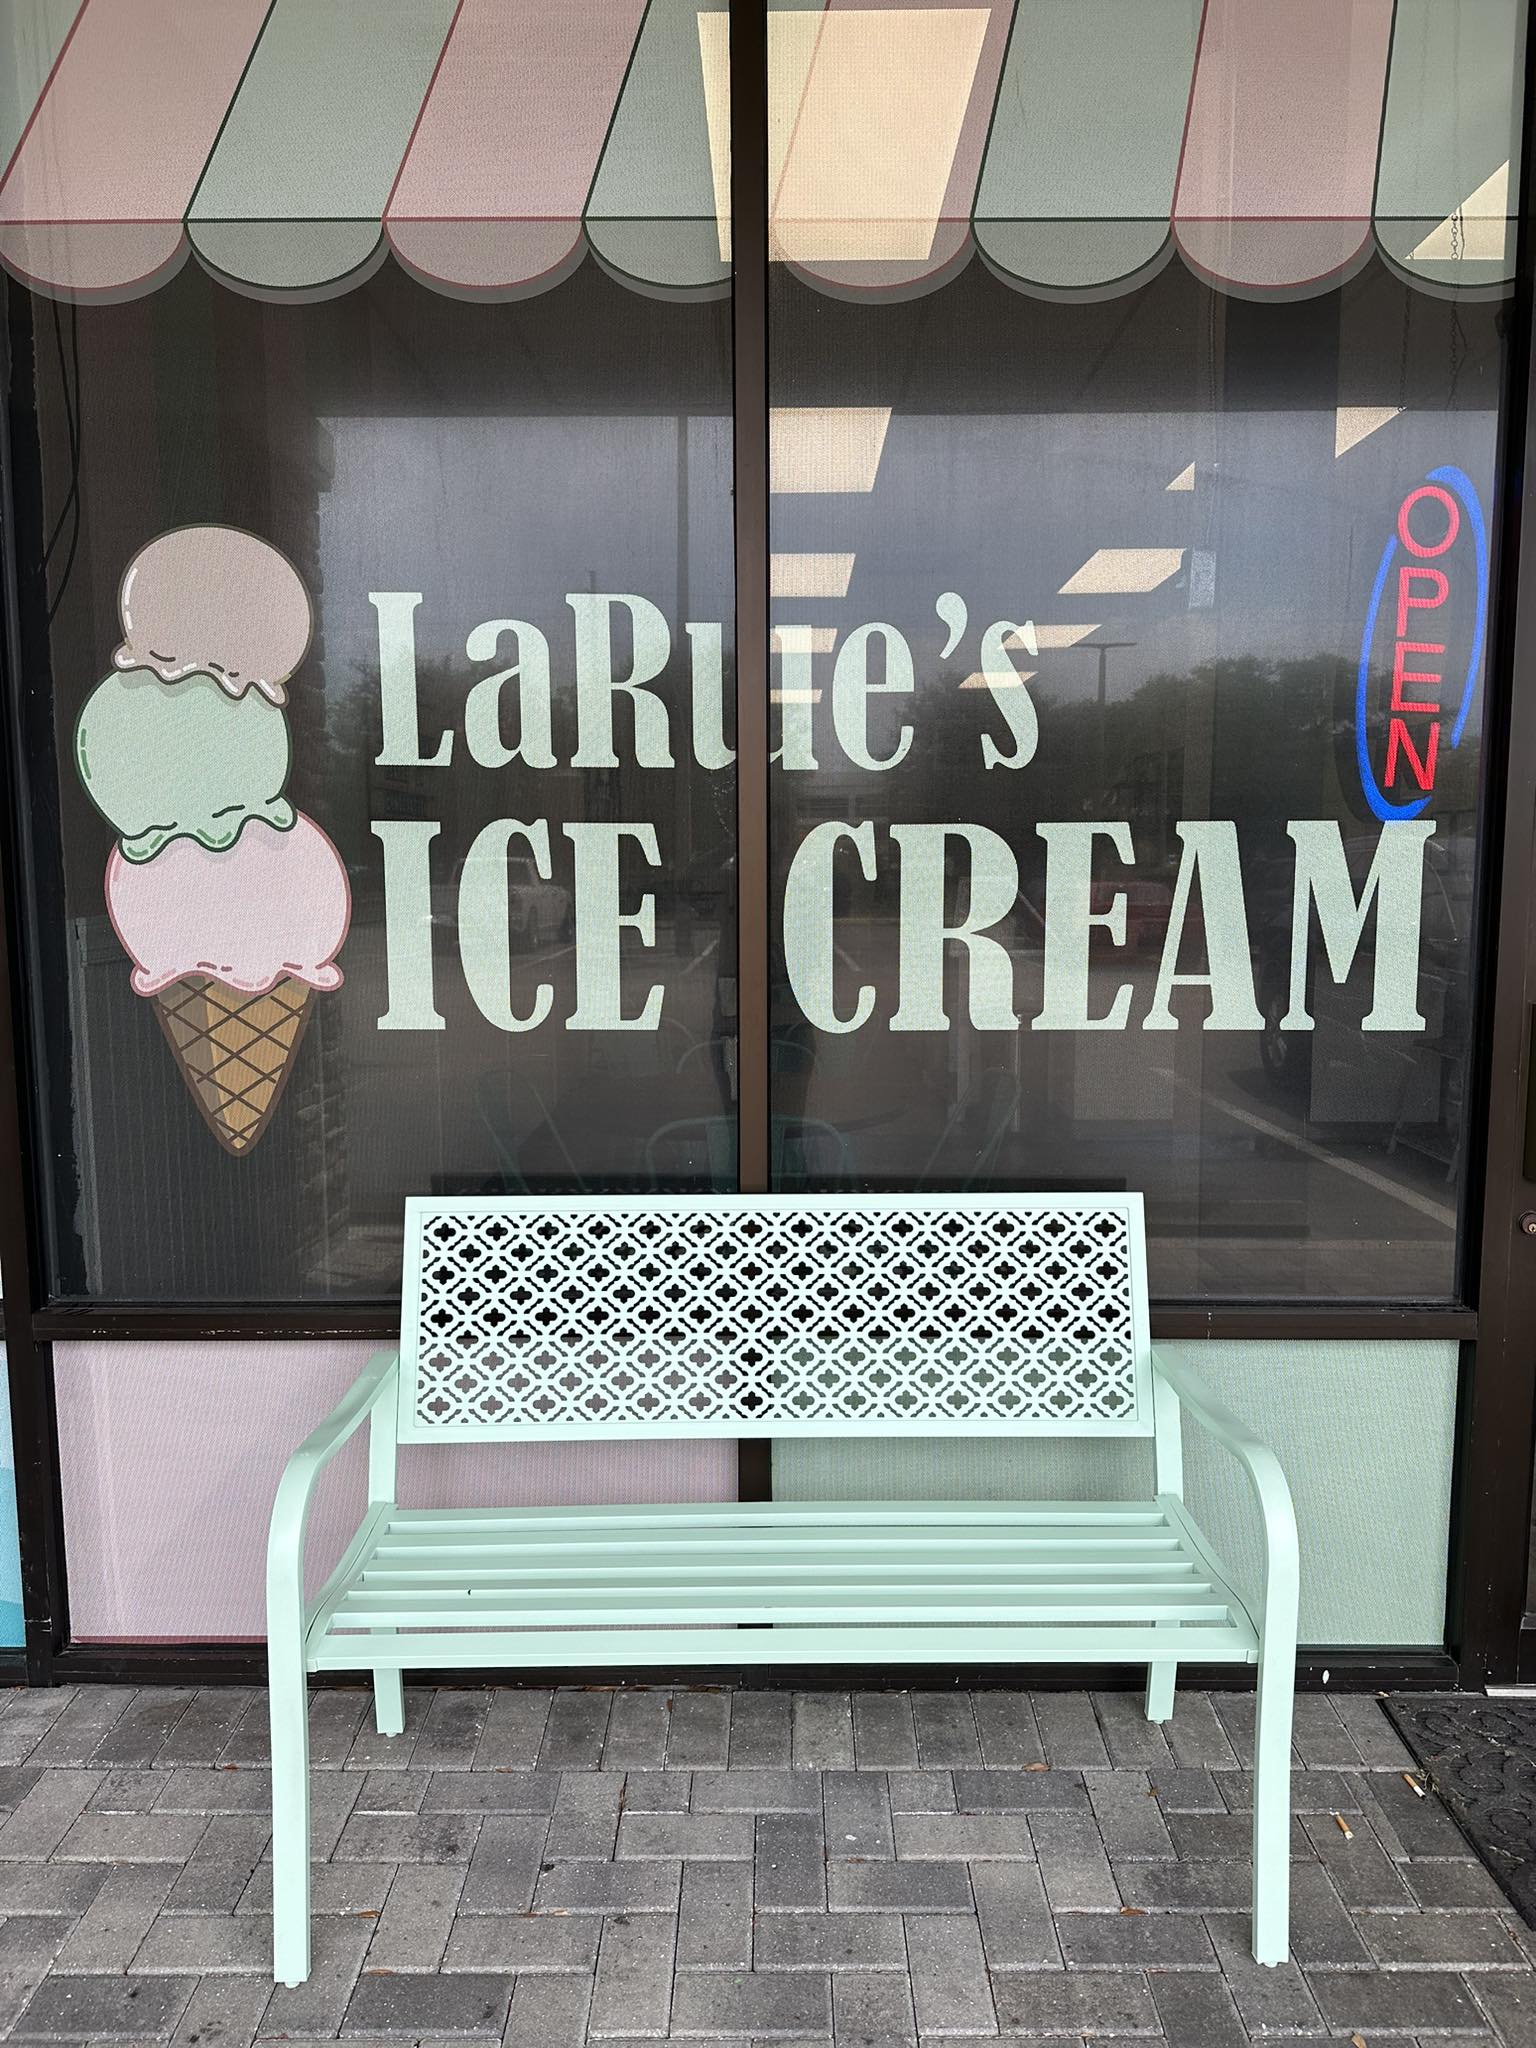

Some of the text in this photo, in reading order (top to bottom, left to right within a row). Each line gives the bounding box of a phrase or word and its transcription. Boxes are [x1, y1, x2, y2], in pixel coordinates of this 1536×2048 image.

[368, 591, 1039, 771] LaRue's
[1384, 485, 1460, 791] OPEN
[370, 817, 1437, 1034] ICE CREAM
